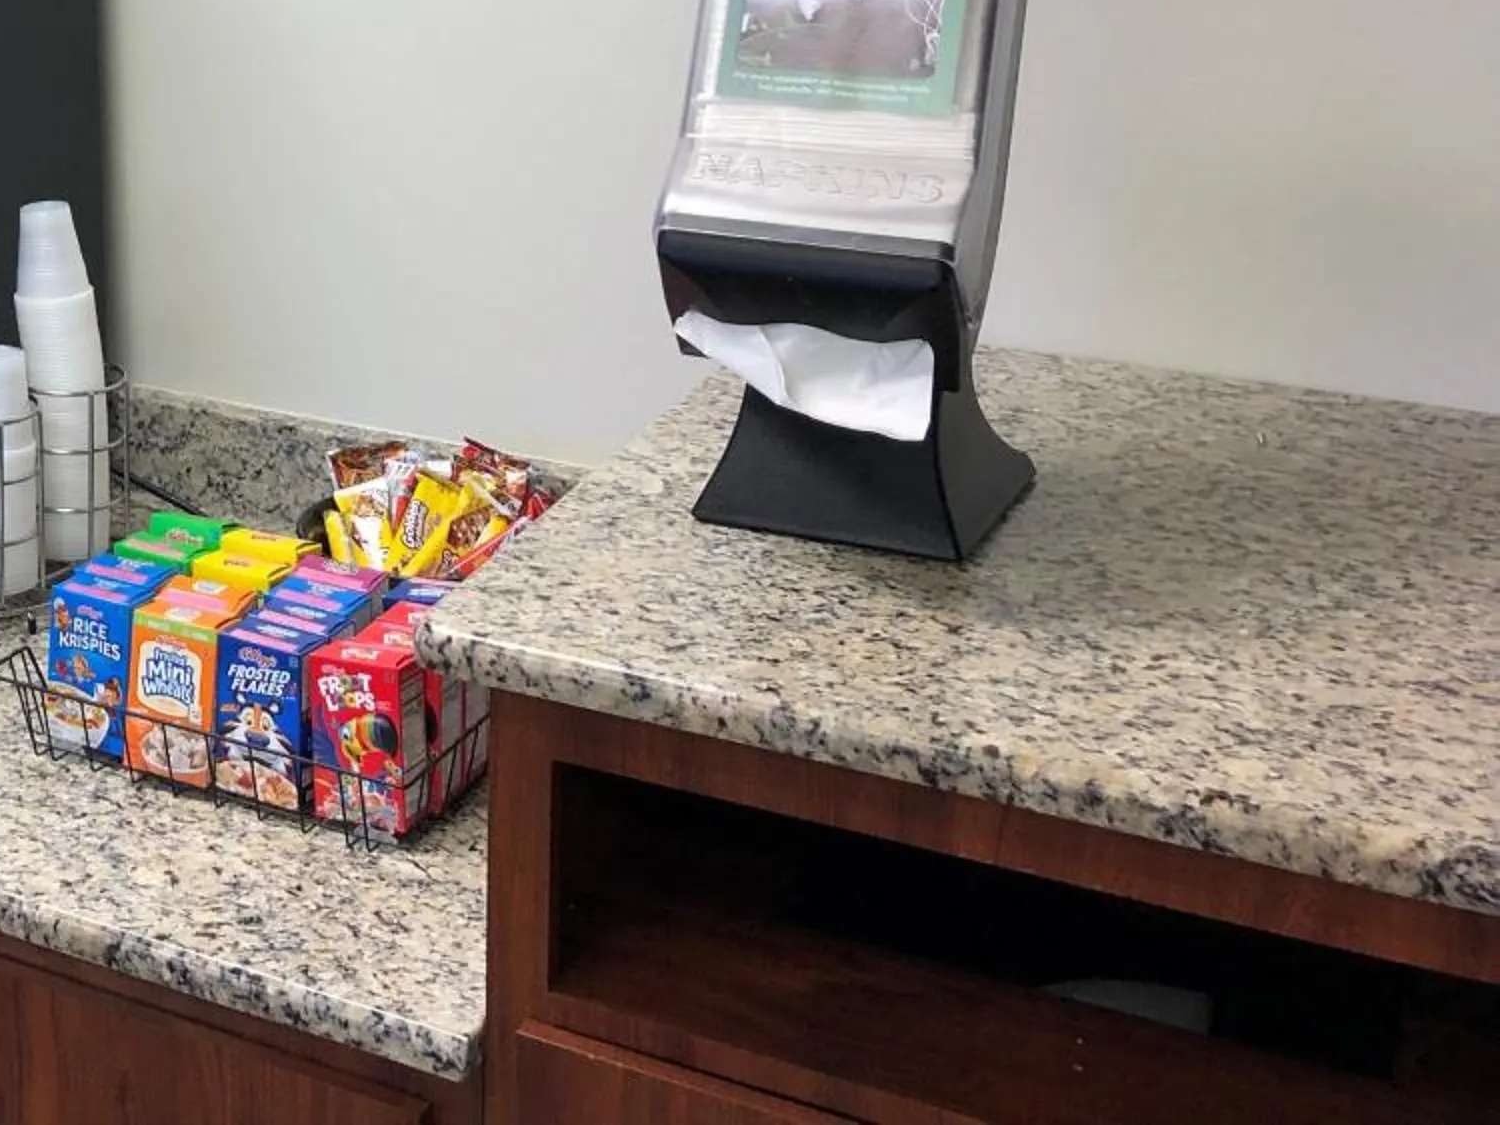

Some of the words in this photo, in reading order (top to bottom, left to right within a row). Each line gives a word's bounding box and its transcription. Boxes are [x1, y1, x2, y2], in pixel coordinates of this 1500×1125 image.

[73, 617, 108, 639] RICE
[59, 631, 121, 662] KRISPIES
[148, 659, 193, 686] Mini
[228, 663, 291, 685] FROSTED
[143, 677, 194, 705] Wheats
[231, 678, 284, 698] FLAKES
